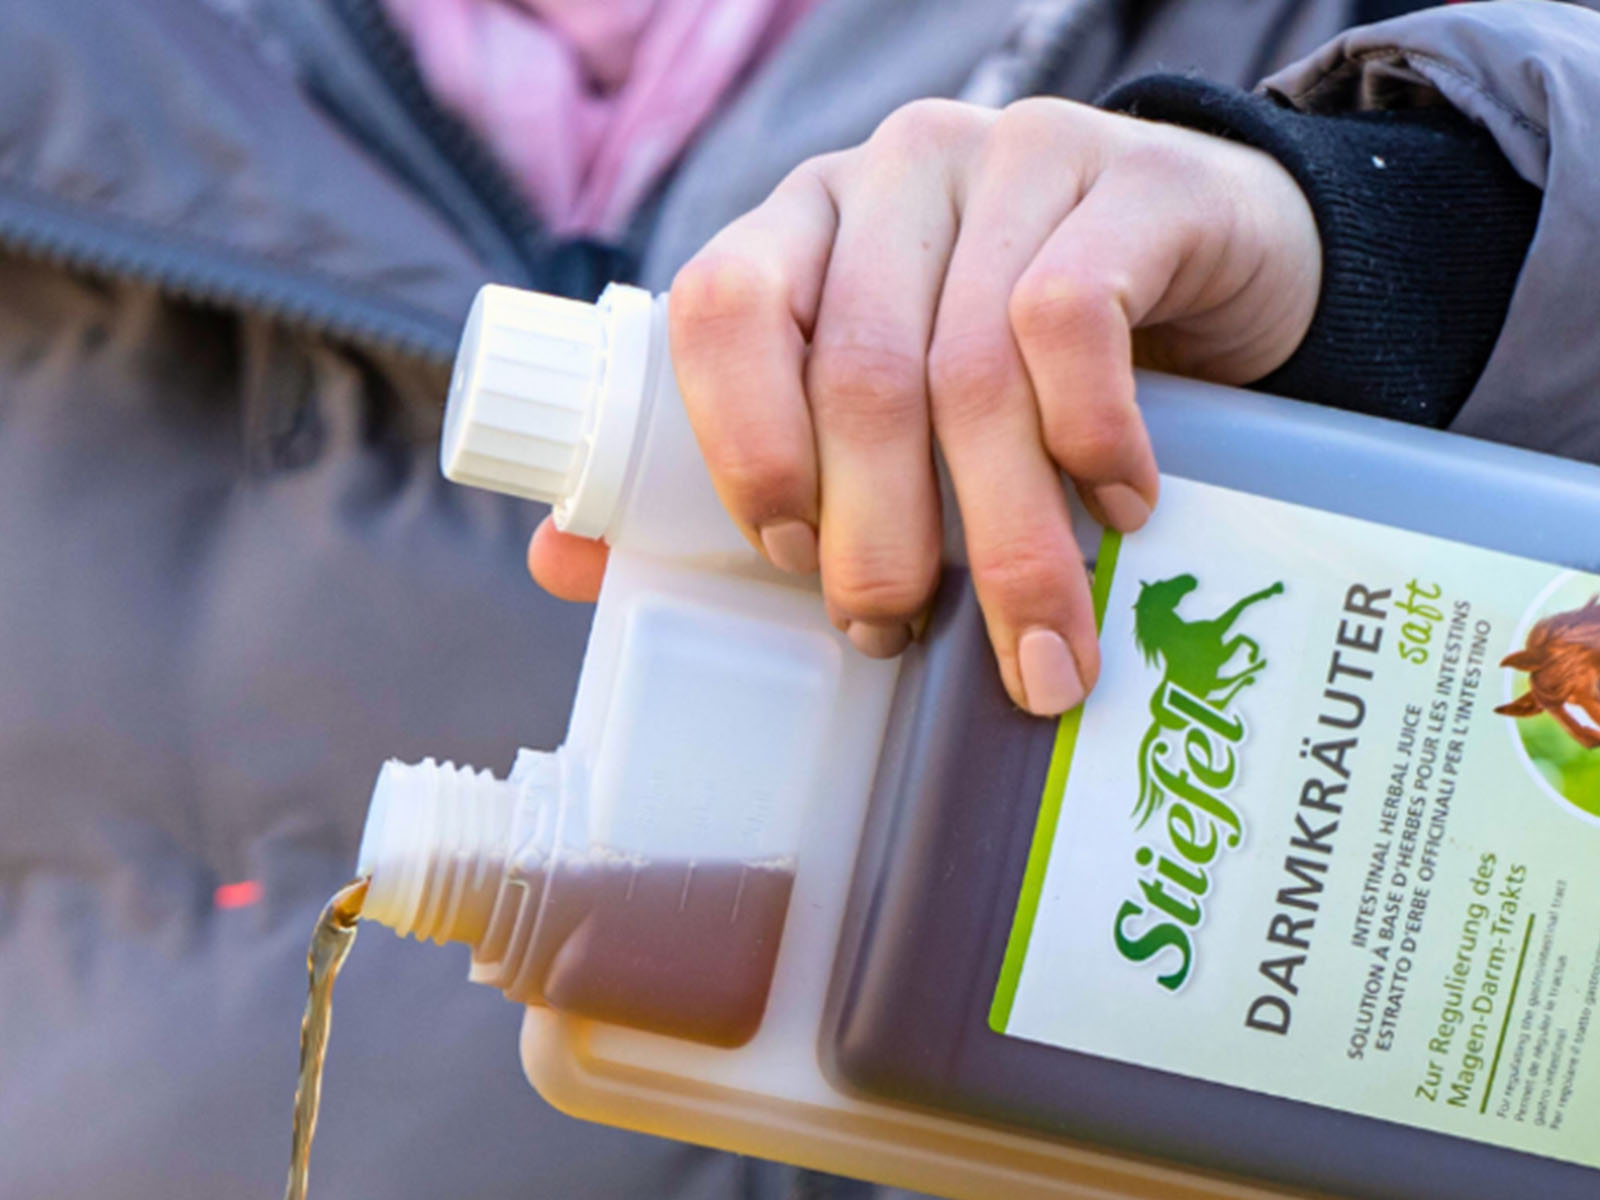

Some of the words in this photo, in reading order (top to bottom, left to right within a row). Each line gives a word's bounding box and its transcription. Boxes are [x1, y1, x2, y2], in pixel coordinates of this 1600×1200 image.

[1394, 578, 1444, 665] saft
[1436, 600, 1471, 696] INTESTINS
[1427, 699, 1448, 734] LES
[1452, 619, 1491, 735] L'INTESTINO
[1414, 736, 1440, 791] POUR
[1443, 739, 1464, 775] PER
[1113, 685, 1244, 992] Stiefel
[1245, 583, 1392, 1037] DARMKRÄUTER
[1352, 840, 1391, 948] INTESTINAL
[1379, 762, 1409, 835] HERBAL
[1397, 703, 1422, 757] JUICE
[1391, 796, 1426, 888] D'HERBES
[1418, 778, 1455, 882] OFFICINALI
[1378, 891, 1403, 941] BASE
[1401, 887, 1430, 953] D'ERBE
[1469, 853, 1496, 896] des
[1372, 944, 1390, 962] À
[1428, 903, 1490, 1055] Regulierung
[1446, 864, 1527, 1108] Magen-Darm-Trakts
[1347, 965, 1385, 1060] SOLUTION
[1375, 957, 1412, 1052] ESTRATTO
[1415, 1060, 1444, 1102] Zur
[1496, 1098, 1511, 1119] For
[1504, 1033, 1531, 1096] regulating
[1521, 1010, 1533, 1031] the
